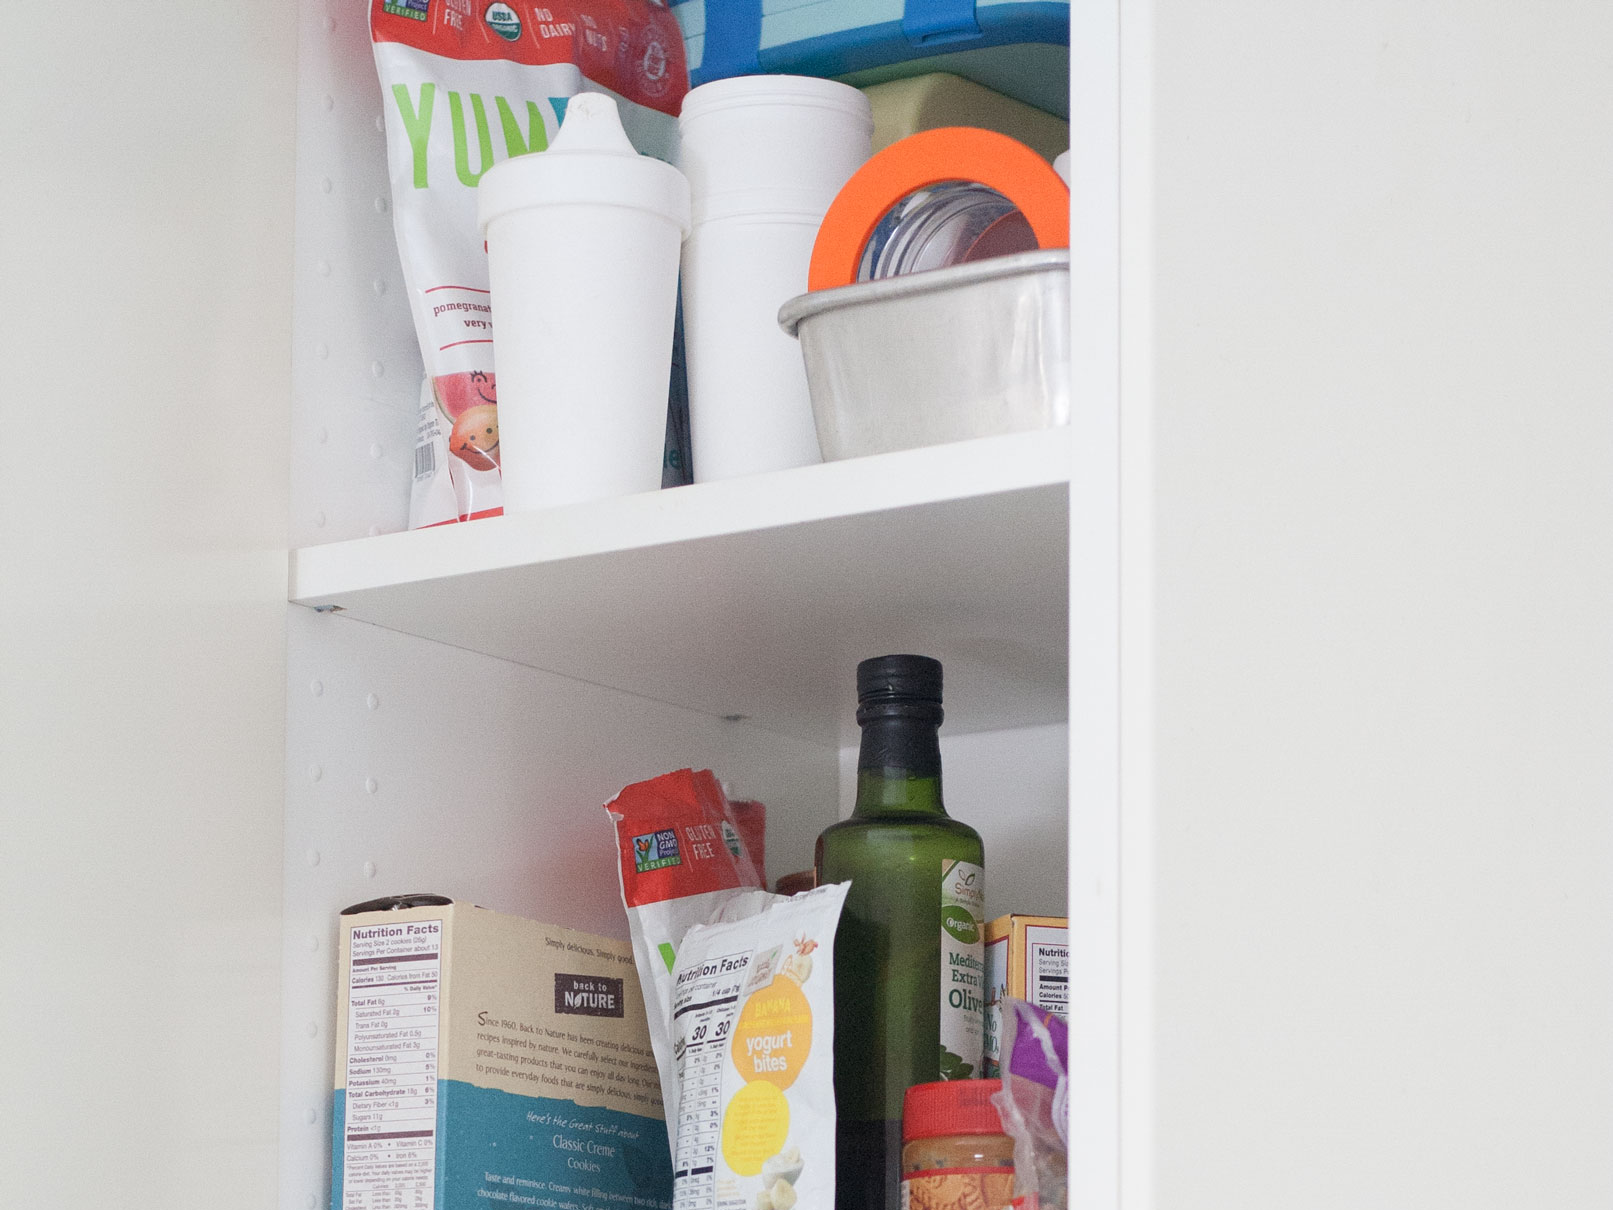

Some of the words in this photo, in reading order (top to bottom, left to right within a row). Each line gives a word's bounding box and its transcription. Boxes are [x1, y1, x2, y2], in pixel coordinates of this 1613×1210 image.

[384, 3, 427, 21] VERIFIED
[535, 8, 553, 22] NO
[540, 23, 577, 39] DAIRY
[464, 319, 487, 330] very
[656, 831, 675, 842] NON
[659, 839, 678, 850] GMO
[692, 842, 715, 860] FREE
[353, 927, 403, 940] Nutrition
[406, 924, 440, 936] Facts
[946, 916, 976, 932] Organic
[352, 949, 376, 957] Servings
[387, 946, 413, 955] Container
[719, 956, 749, 975] Facts
[1039, 959, 1060, 969] Serving
[1039, 967, 1062, 977] Servings
[351, 977, 375, 985] Calories
[952, 968, 978, 985] Extra
[572, 980, 595, 991] back
[598, 984, 608, 992] to
[1039, 984, 1063, 992] Amount
[948, 988, 985, 1014] Olive
[1039, 993, 1063, 1001] Calories
[477, 1011, 500, 1027] Since
[519, 1022, 535, 1034] Back
[545, 1027, 566, 1039] Nature
[566, 1033, 578, 1043] has
[692, 1025, 708, 1042] 30
[715, 1020, 731, 1038] 30
[476, 1032, 500, 1045] recipes
[501, 1036, 527, 1050] inspired
[528, 1041, 538, 1053] by
[561, 1047, 573, 1058] We
[745, 1031, 793, 1057] yogurt
[520, 1055, 549, 1071] products
[564, 1065, 577, 1077] you
[753, 1052, 788, 1073] bites
[349, 1067, 371, 1076] Sodium
[484, 1067, 510, 1081] provide
[510, 1069, 540, 1085] everyday
[540, 1074, 560, 1087] foods
[348, 1091, 363, 1100] Total
[364, 1088, 406, 1099] Carbohydrate
[347, 1126, 369, 1134] Protein
[552, 1114, 568, 1128] the
[568, 1119, 595, 1131] Great
[552, 1134, 585, 1154] Classic
[586, 1141, 616, 1158] Creme
[566, 1157, 602, 1174] Cookies
[502, 1175, 515, 1185] and
